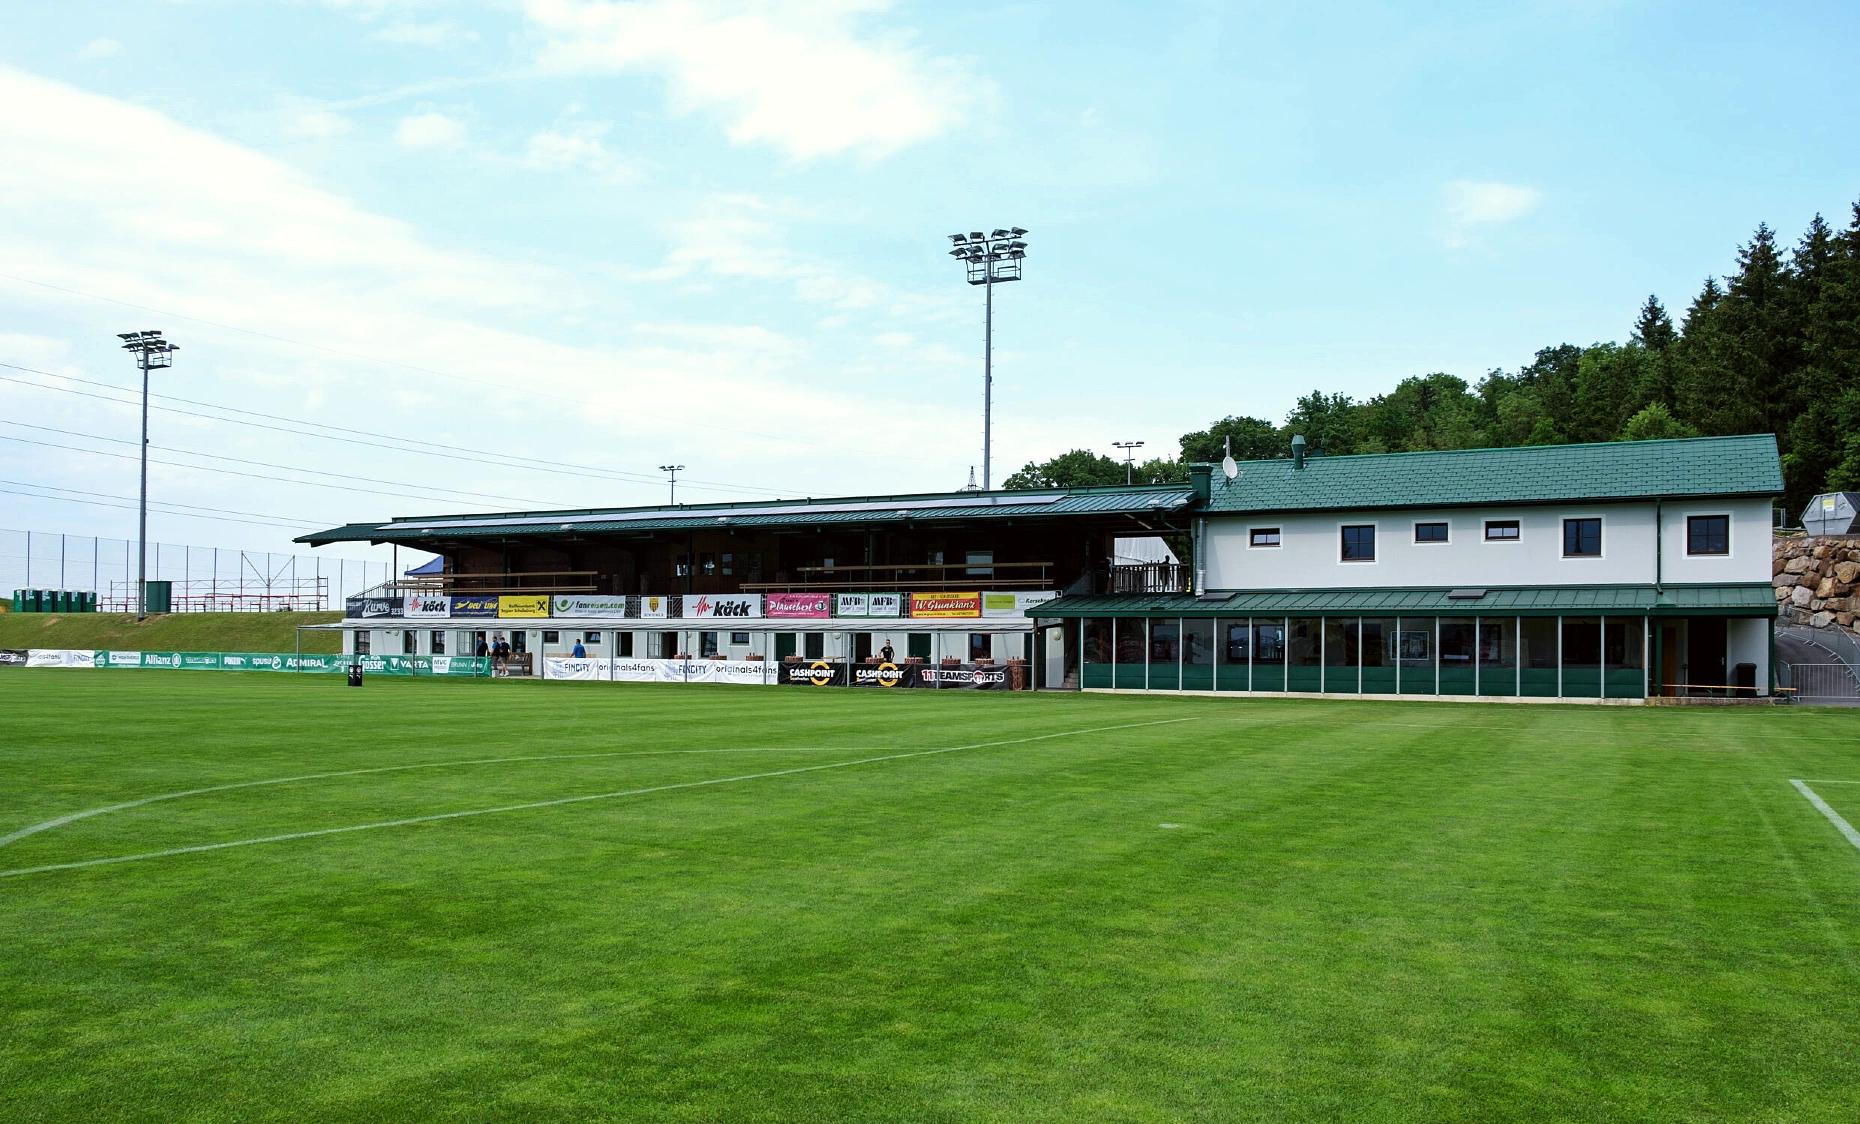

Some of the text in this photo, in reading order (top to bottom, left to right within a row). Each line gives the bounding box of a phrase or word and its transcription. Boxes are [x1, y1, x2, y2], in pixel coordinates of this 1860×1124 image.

[362, 599, 390, 613] Kurve
[421, 601, 446, 612] köck
[575, 601, 625, 609] fanreisen.com
[145, 654, 172, 665] Allianz
[252, 657, 272, 666] spusu
[286, 658, 329, 668] ADMIRAL
[789, 669, 836, 678] CASHPOINT
[855, 669, 904, 679] CASHPOINT
